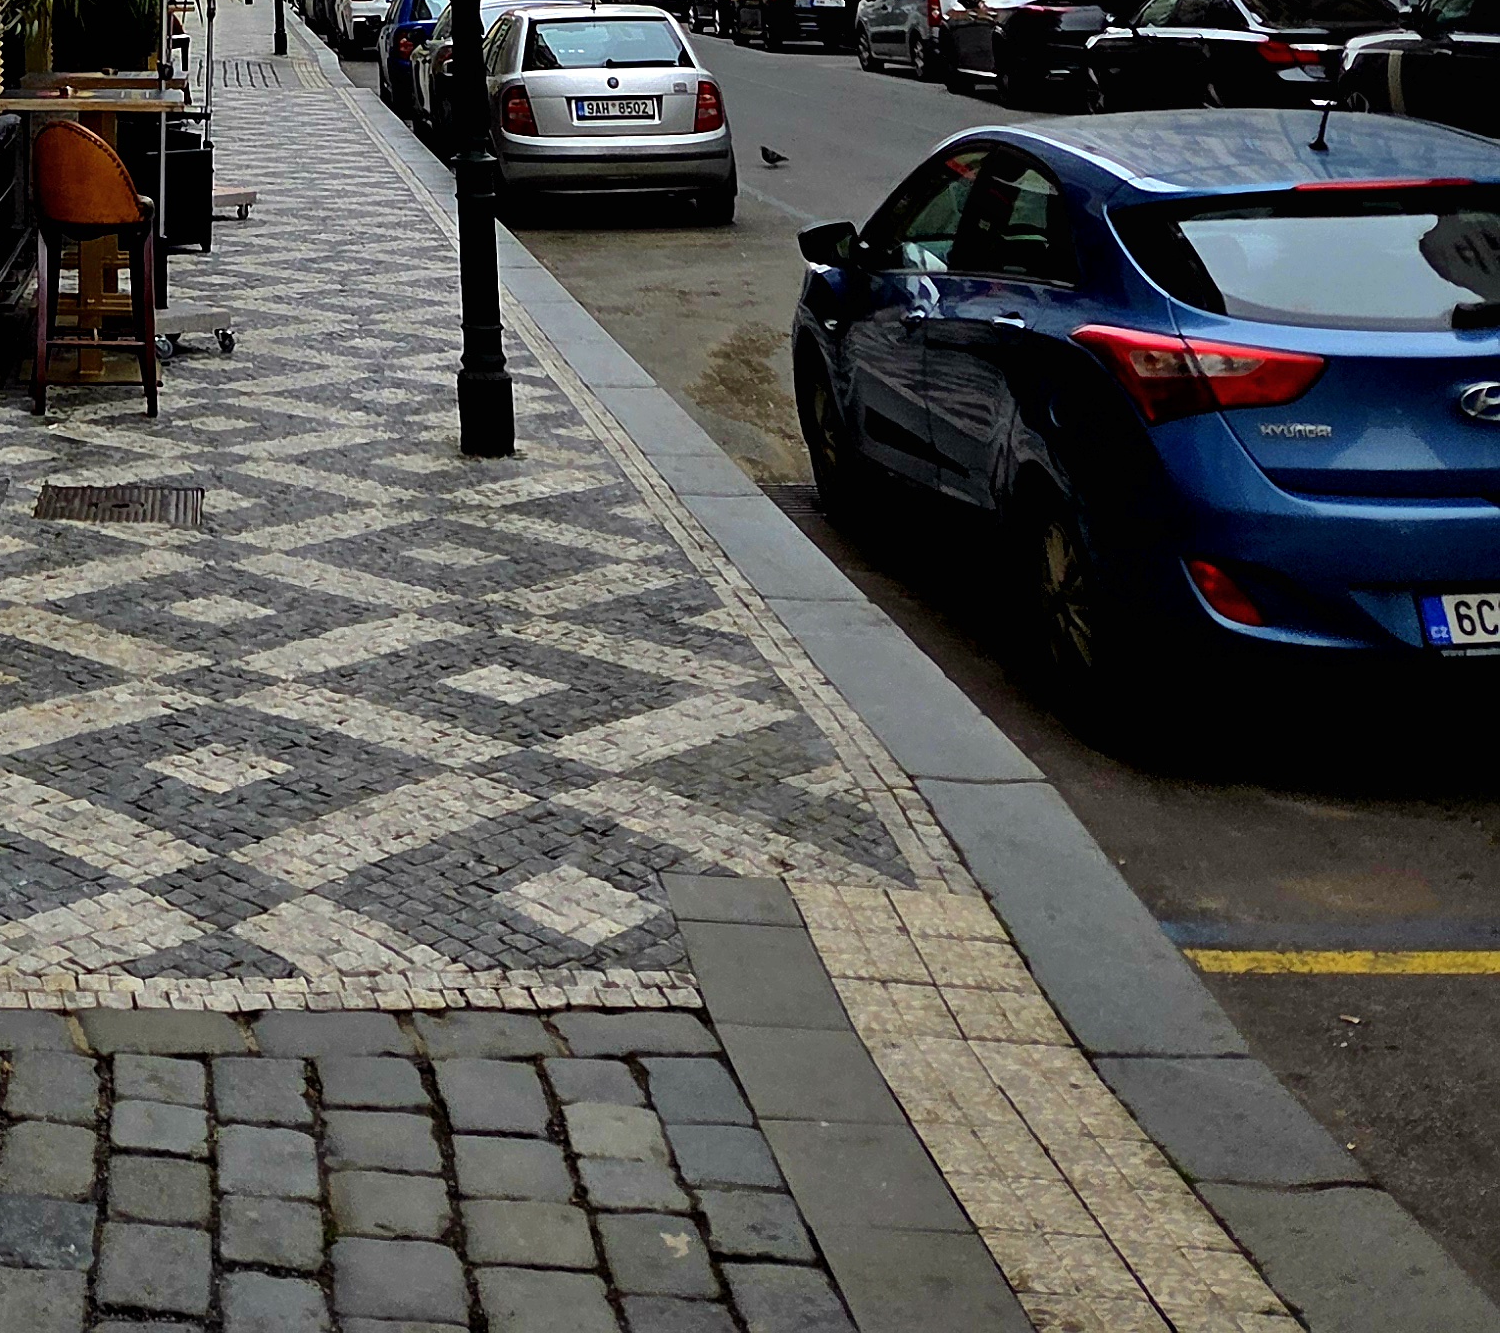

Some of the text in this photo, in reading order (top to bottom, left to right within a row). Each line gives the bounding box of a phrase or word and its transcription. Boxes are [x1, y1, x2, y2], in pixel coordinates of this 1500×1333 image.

[587, 101, 649, 115] 9AH 8502
[1454, 599, 1500, 636] 6C
[1430, 626, 1449, 639] CZ
